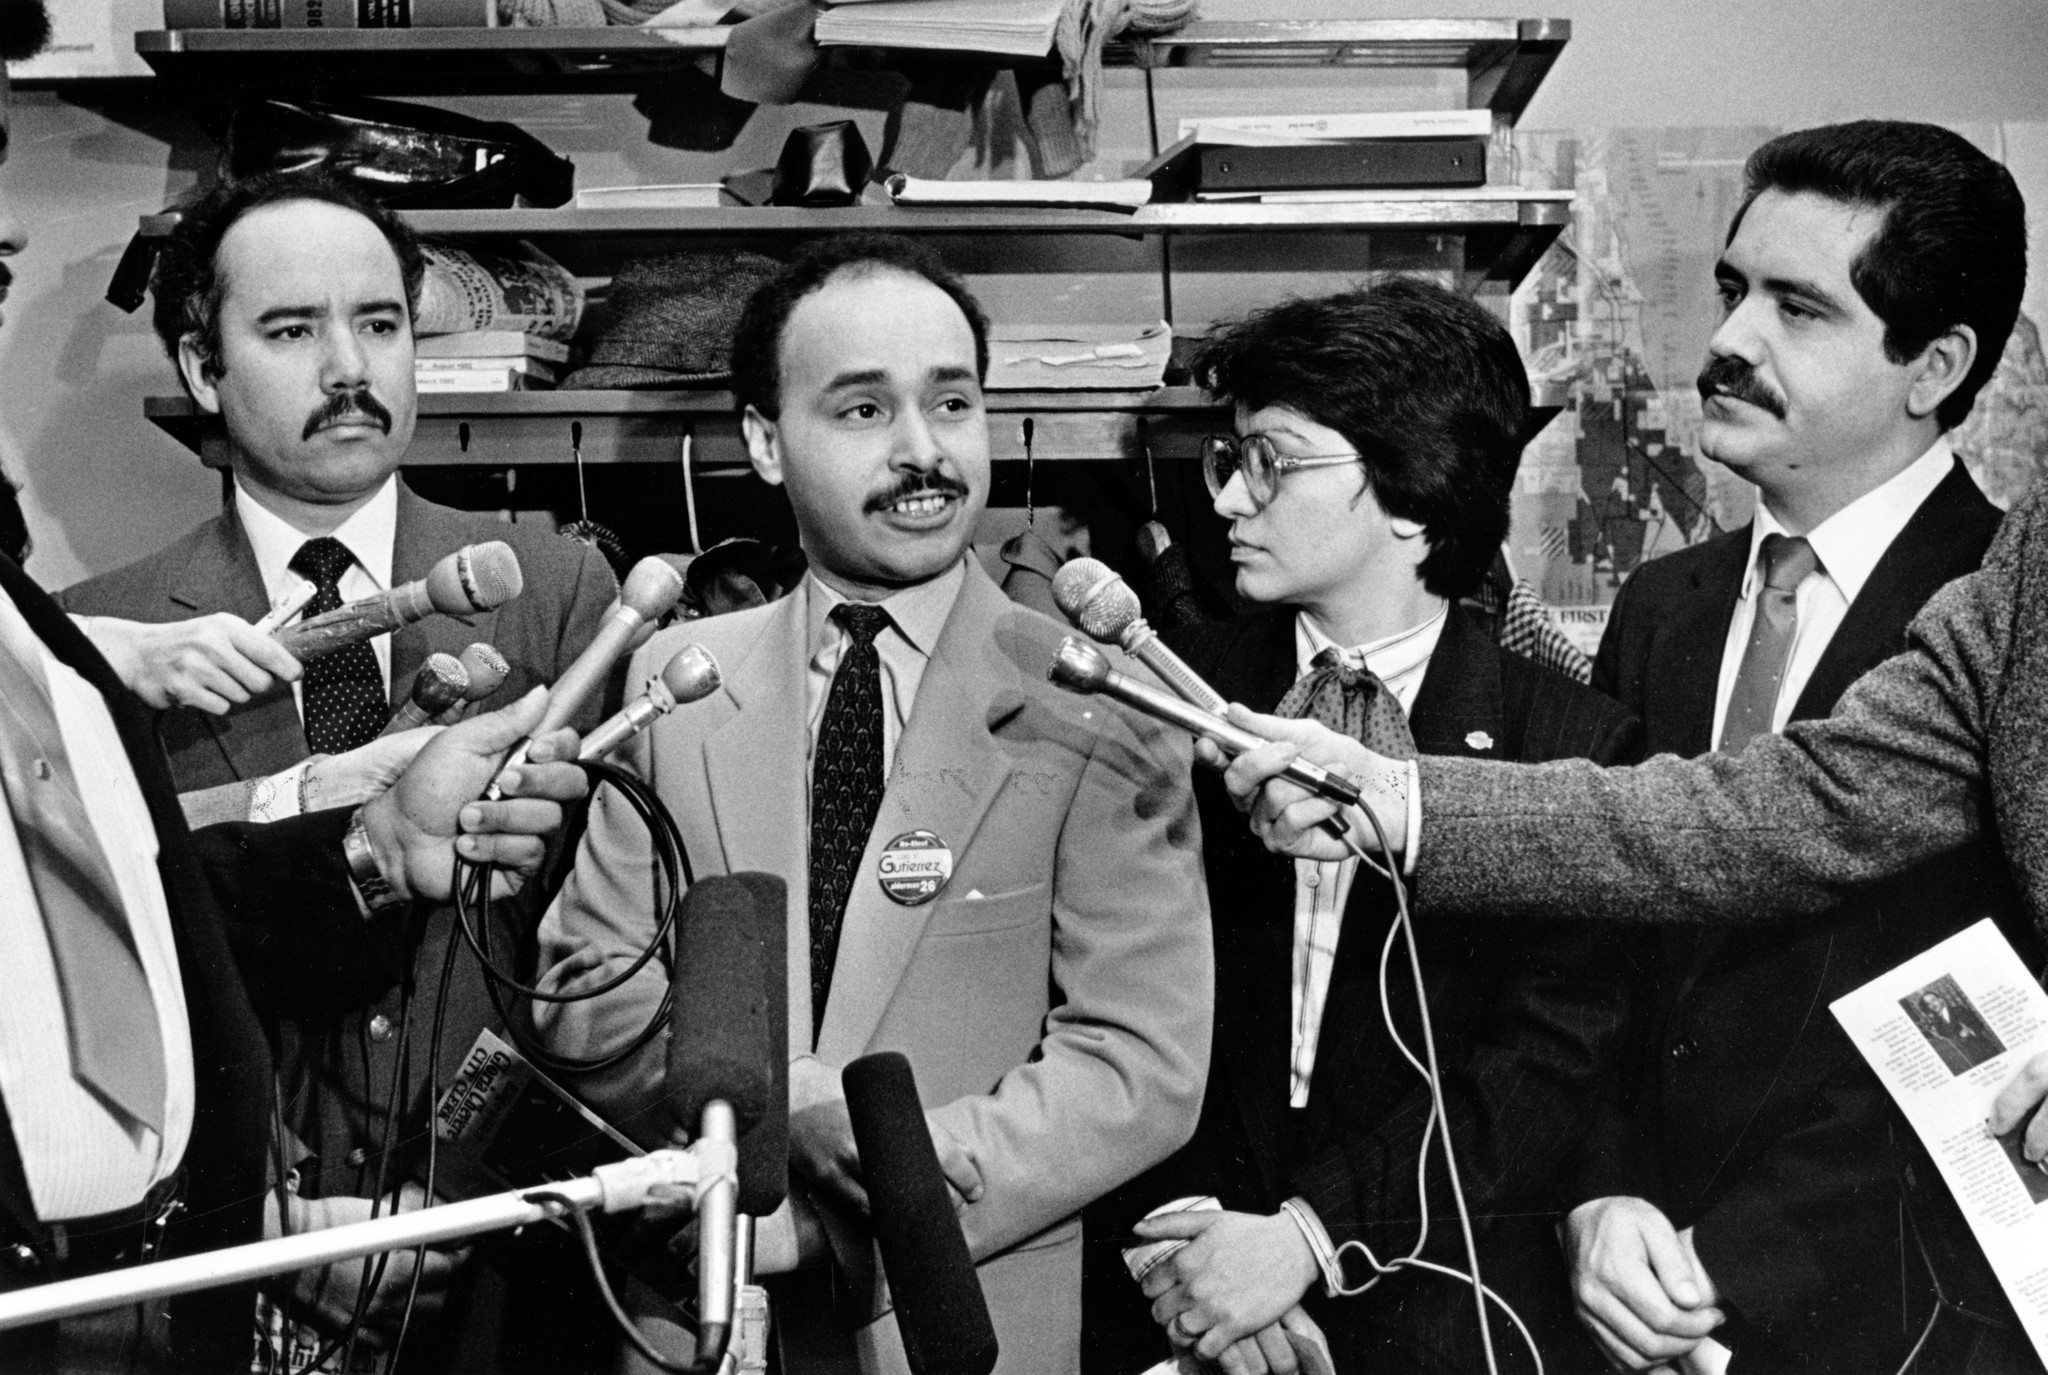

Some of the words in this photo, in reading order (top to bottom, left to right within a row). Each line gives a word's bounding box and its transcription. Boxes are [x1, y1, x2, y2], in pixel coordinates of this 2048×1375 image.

[1560, 609, 1608, 624] FIRST
[879, 854, 945, 875] Gutierrez
[919, 879, 936, 893] 26
[462, 1047, 488, 1081] CITY
[474, 1050, 512, 1094] Gloria
[437, 1078, 469, 1120] CLERK
[446, 1090, 487, 1141] Chevere
